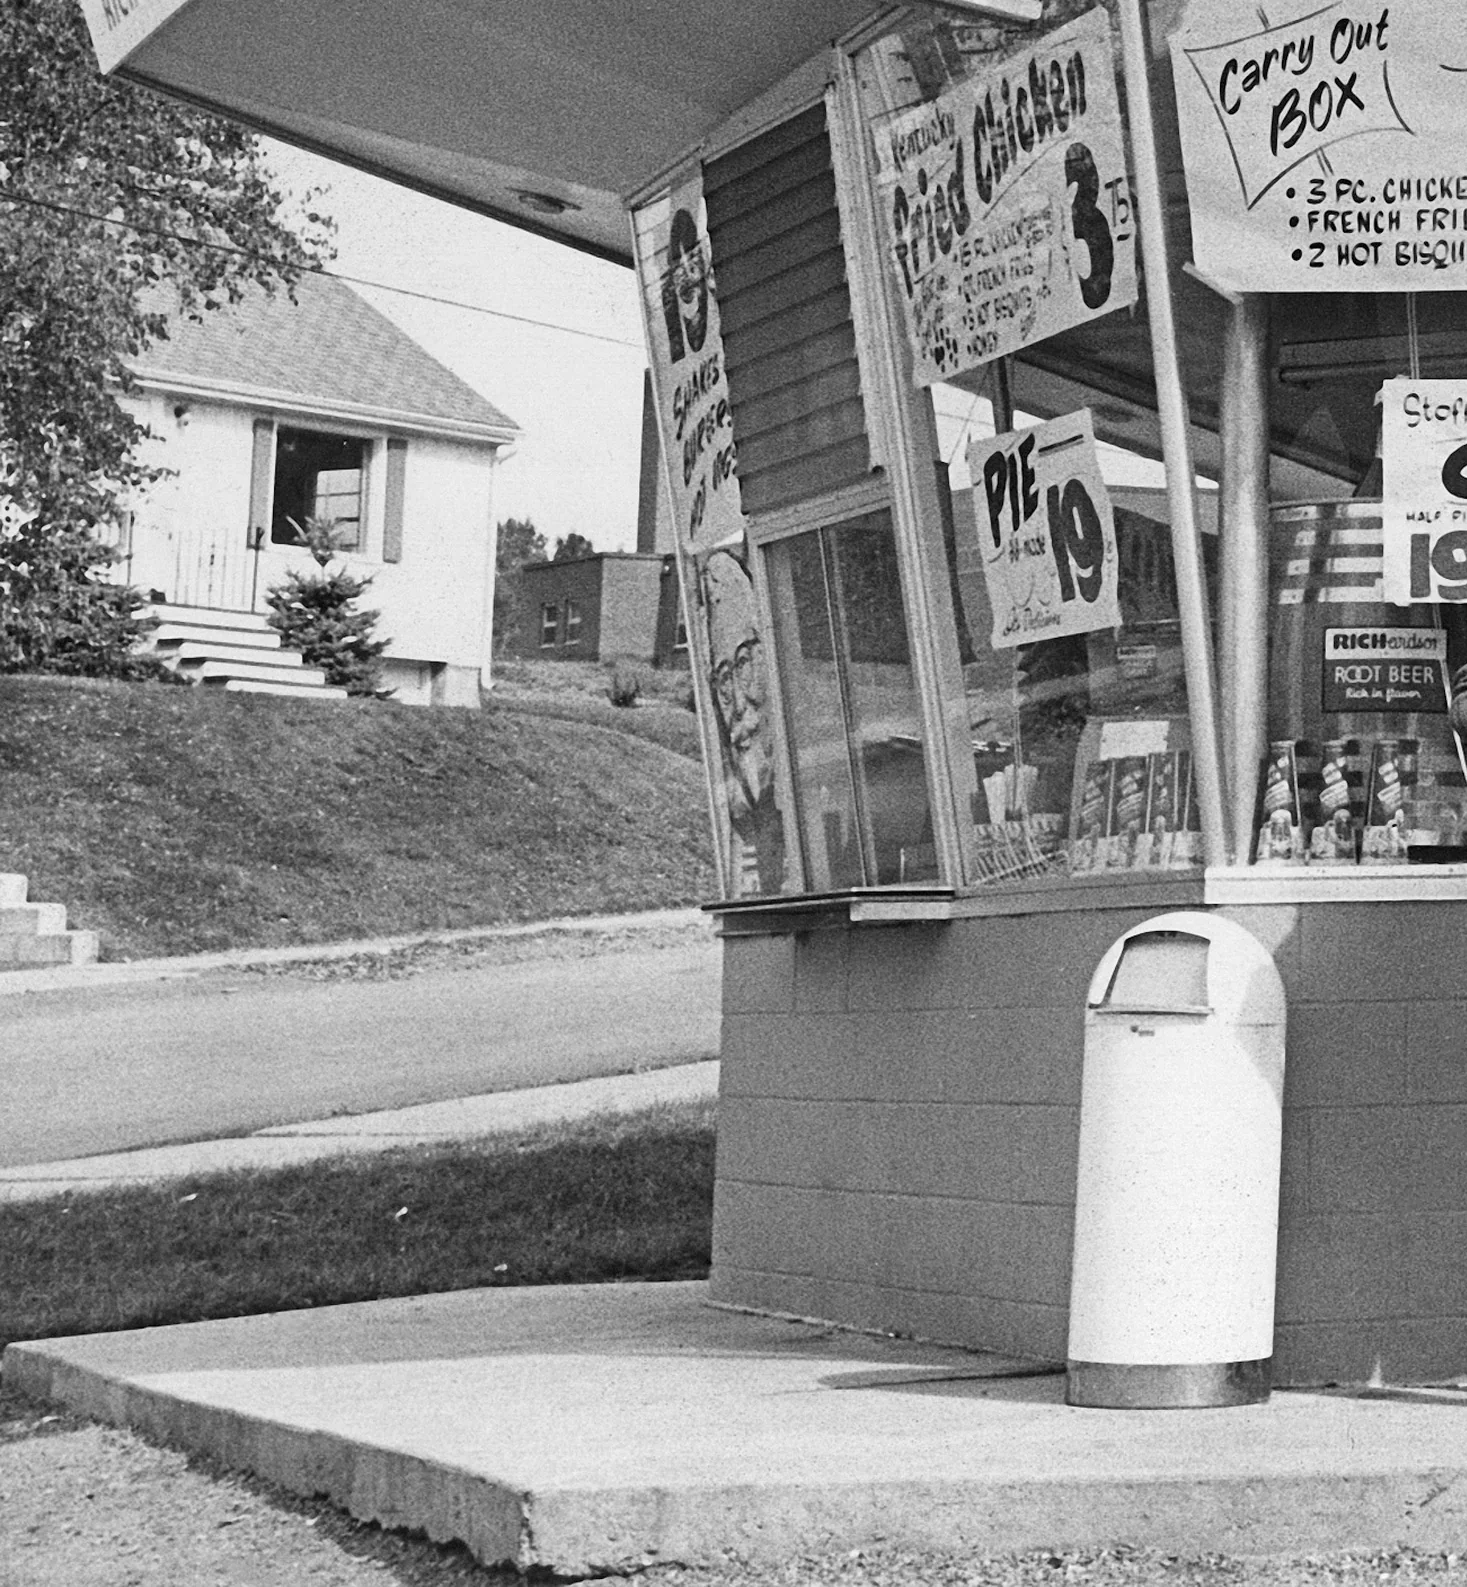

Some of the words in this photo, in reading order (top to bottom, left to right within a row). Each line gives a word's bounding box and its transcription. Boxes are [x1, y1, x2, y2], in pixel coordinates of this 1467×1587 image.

[1218, 30, 1314, 115] Carry
[1329, 8, 1390, 60] Out
[973, 51, 1087, 204] Chicken
[1270, 71, 1366, 157] BOX
[1306, 178, 1327, 205] 3
[1335, 178, 1377, 205] PC.
[1307, 209, 1401, 234] FRENCH
[1308, 241, 1326, 268] 2
[1337, 241, 1383, 267] HOT
[983, 432, 1040, 548] PIE
[1334, 665, 1382, 684] ROOT
[1388, 665, 1434, 684] BEER
